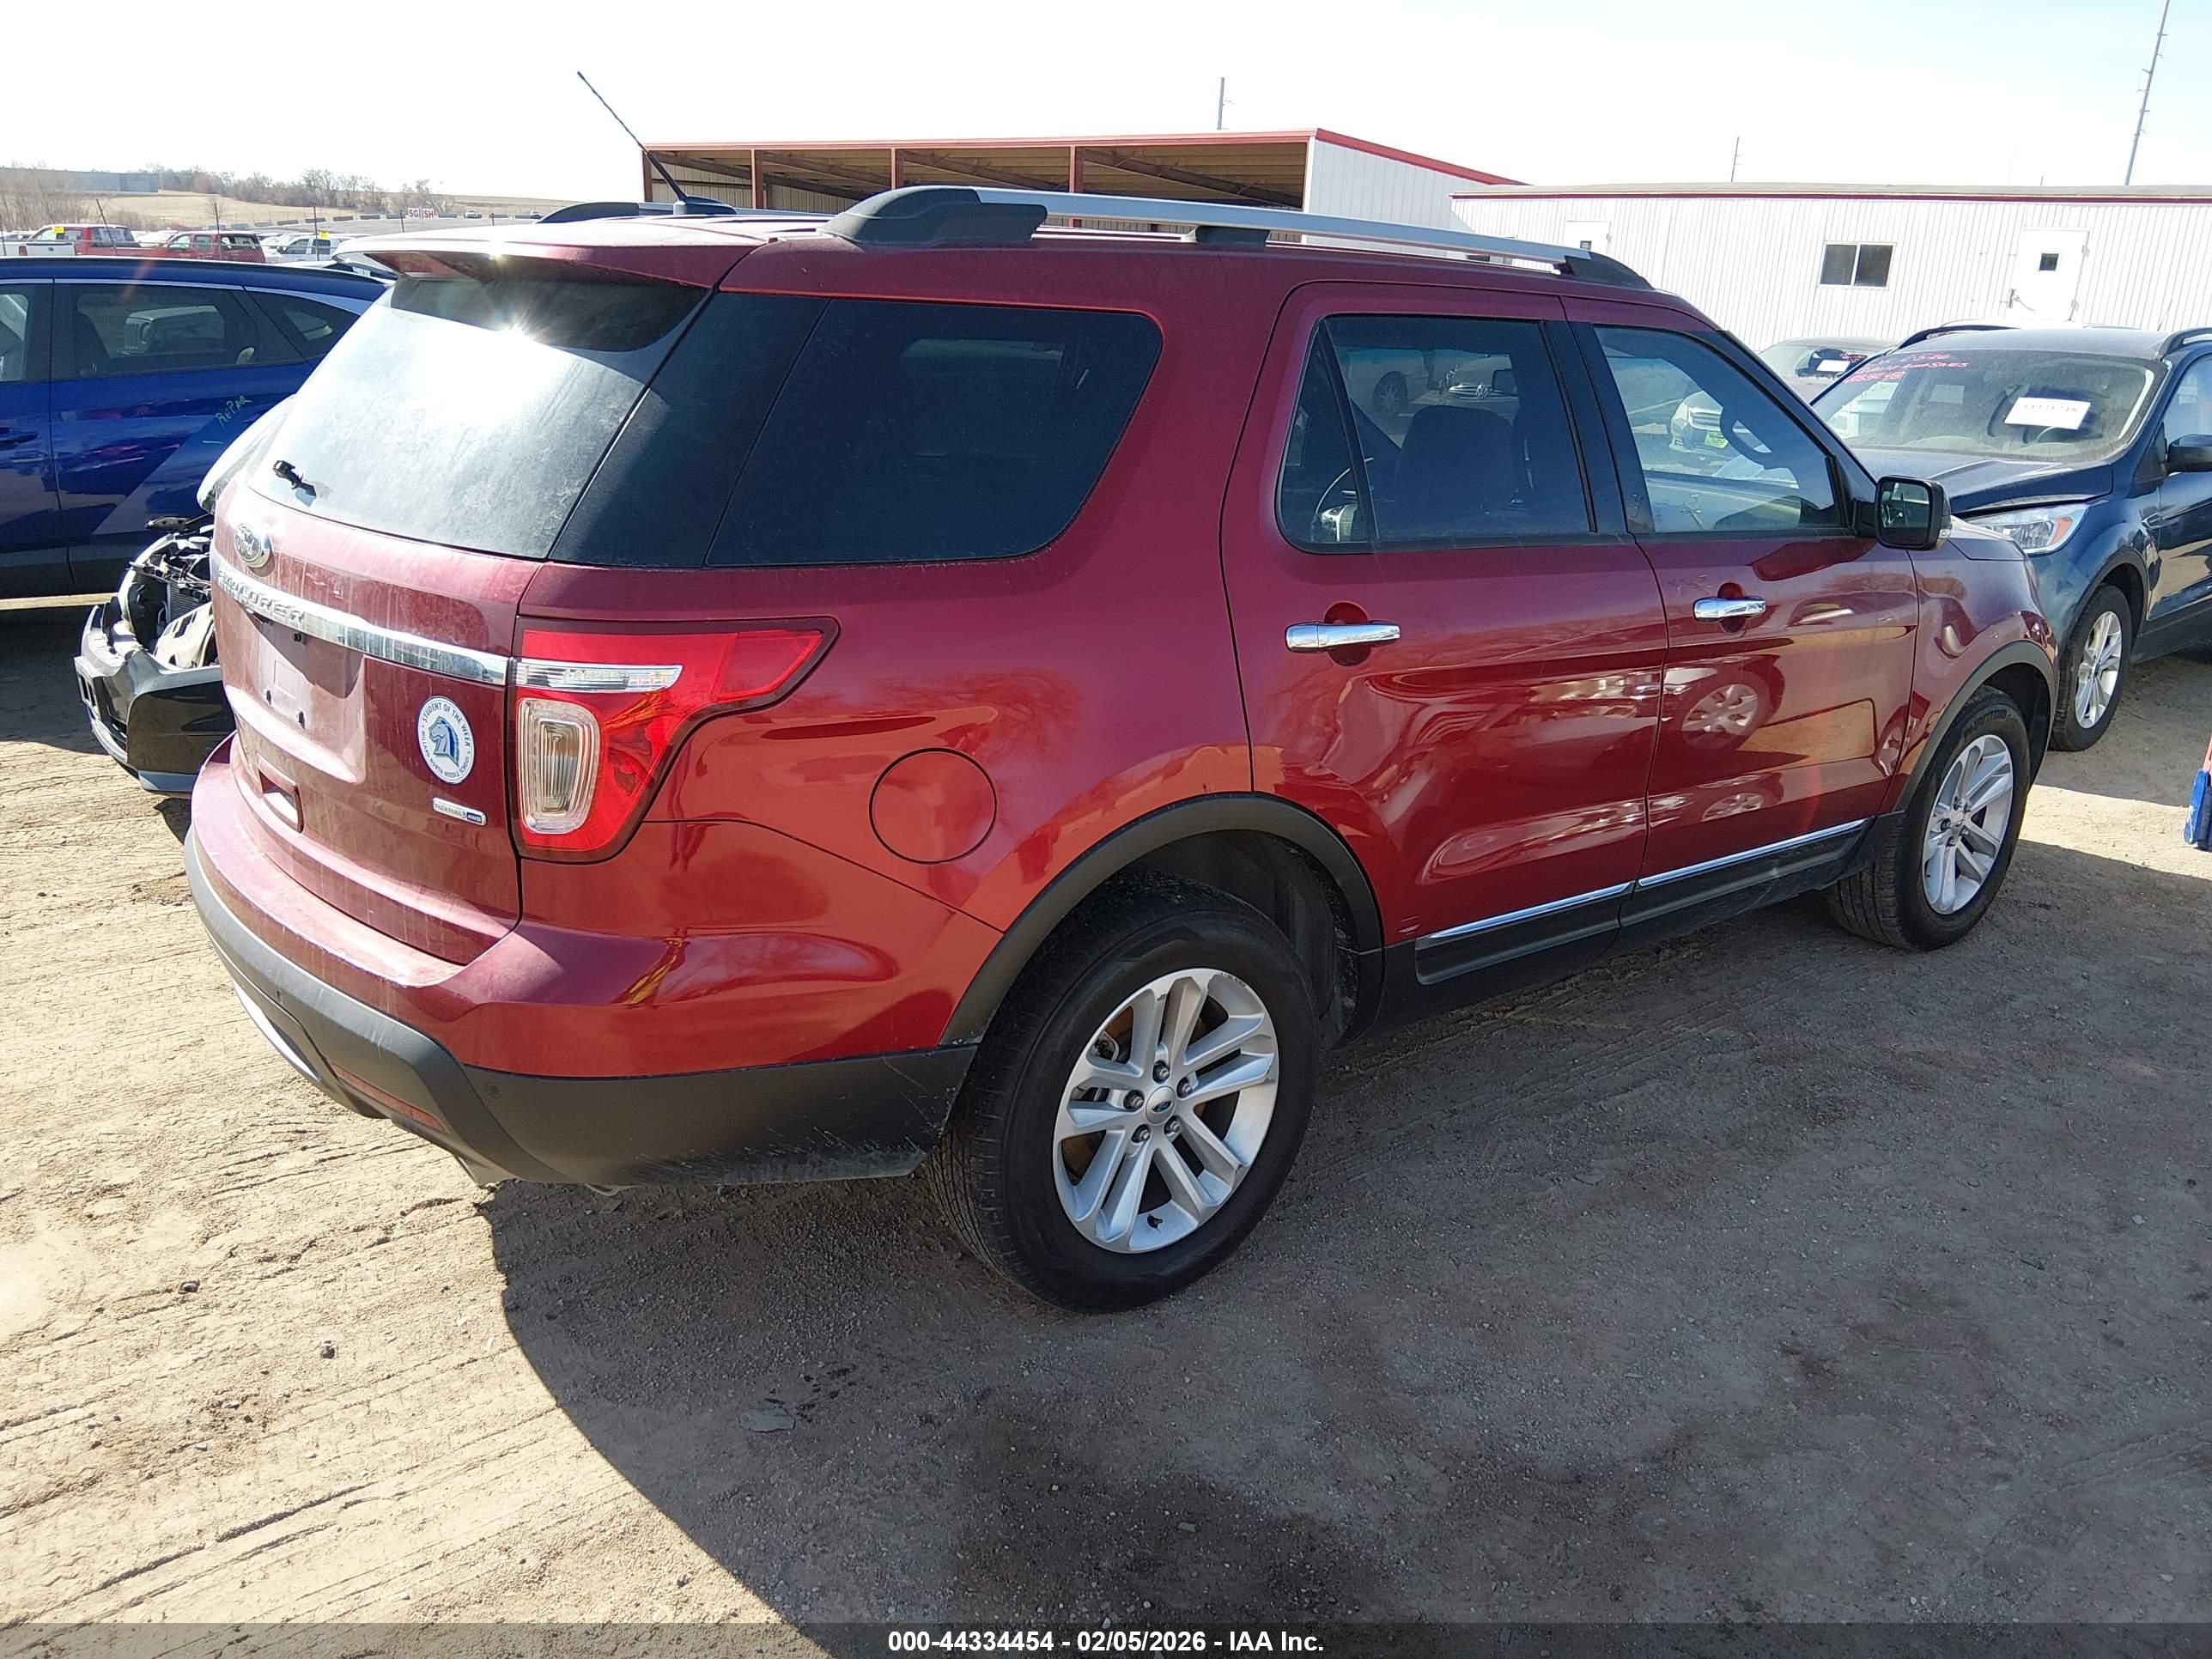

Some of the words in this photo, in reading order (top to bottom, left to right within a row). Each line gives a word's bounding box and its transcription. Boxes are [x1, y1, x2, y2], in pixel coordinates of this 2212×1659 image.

[422, 702, 442, 723] STUDENT
[443, 703, 452, 713] OF
[452, 709, 463, 723] THE
[460, 724, 471, 749] WEEK
[421, 730, 431, 758] MILLARD
[429, 757, 444, 775] NORTH
[459, 755, 471, 775] SCHOOL
